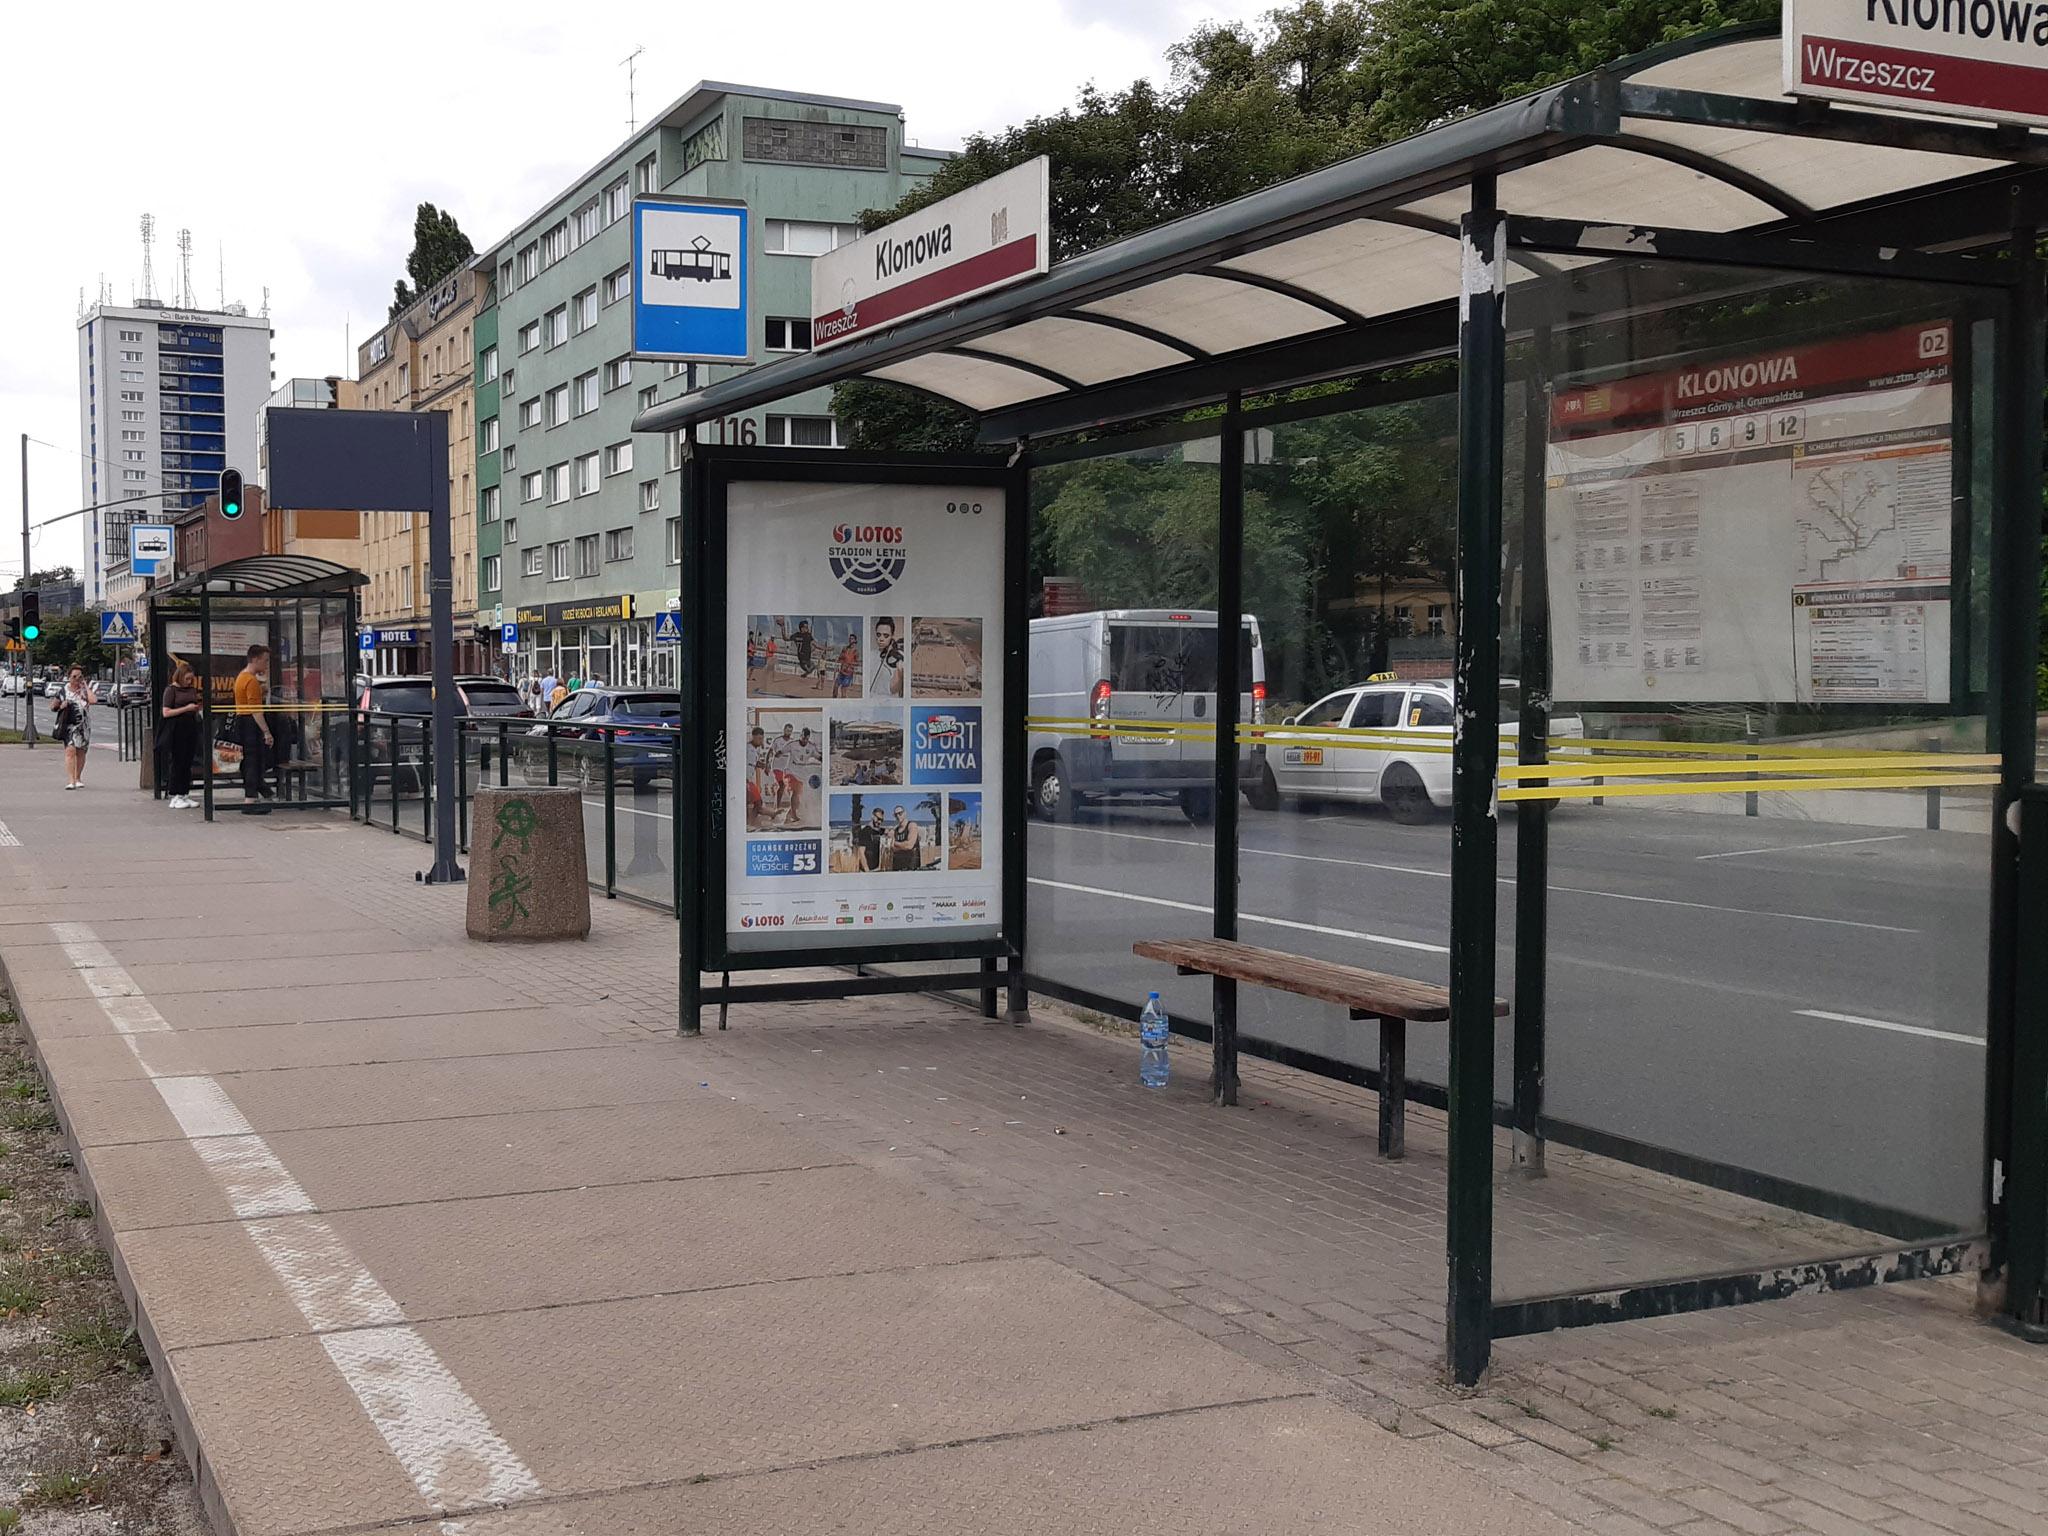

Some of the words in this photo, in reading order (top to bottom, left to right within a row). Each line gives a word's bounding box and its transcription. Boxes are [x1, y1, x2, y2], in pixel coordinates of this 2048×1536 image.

[1807, 44, 1936, 93] Wrzeszcz
[876, 223, 952, 280] Klonowa
[815, 312, 858, 341] Wrzeszcz
[1923, 334, 1945, 352] 02
[1678, 356, 1798, 399] KLONOWA
[1868, 364, 1948, 387] www.ztm.gda.pl
[1671, 405, 1707, 418] Wrzeszcz
[1747, 390, 1804, 407] Grunwaldzka
[714, 416, 757, 446] 116
[1675, 432, 1685, 450] 5
[1710, 426, 1720, 446] 6
[1745, 421, 1756, 441] 9
[1778, 415, 1797, 436] 12
[855, 526, 903, 544] LOTOS
[829, 547, 872, 557] STADION
[876, 548, 906, 558] LETNI
[518, 609, 531, 623] SANTI
[362, 635, 372, 648] P
[381, 631, 412, 642] HOTEL
[505, 626, 514, 640] P
[1376, 672, 1397, 681] TAXI
[915, 752, 977, 769] MUZYKA
[752, 843, 782, 852] GDAŃSK
[752, 854, 780, 863] PLAŻA
[752, 862, 790, 871] WEJŚCIE
[793, 853, 816, 871] 53
[755, 915, 785, 926] LOTOS
